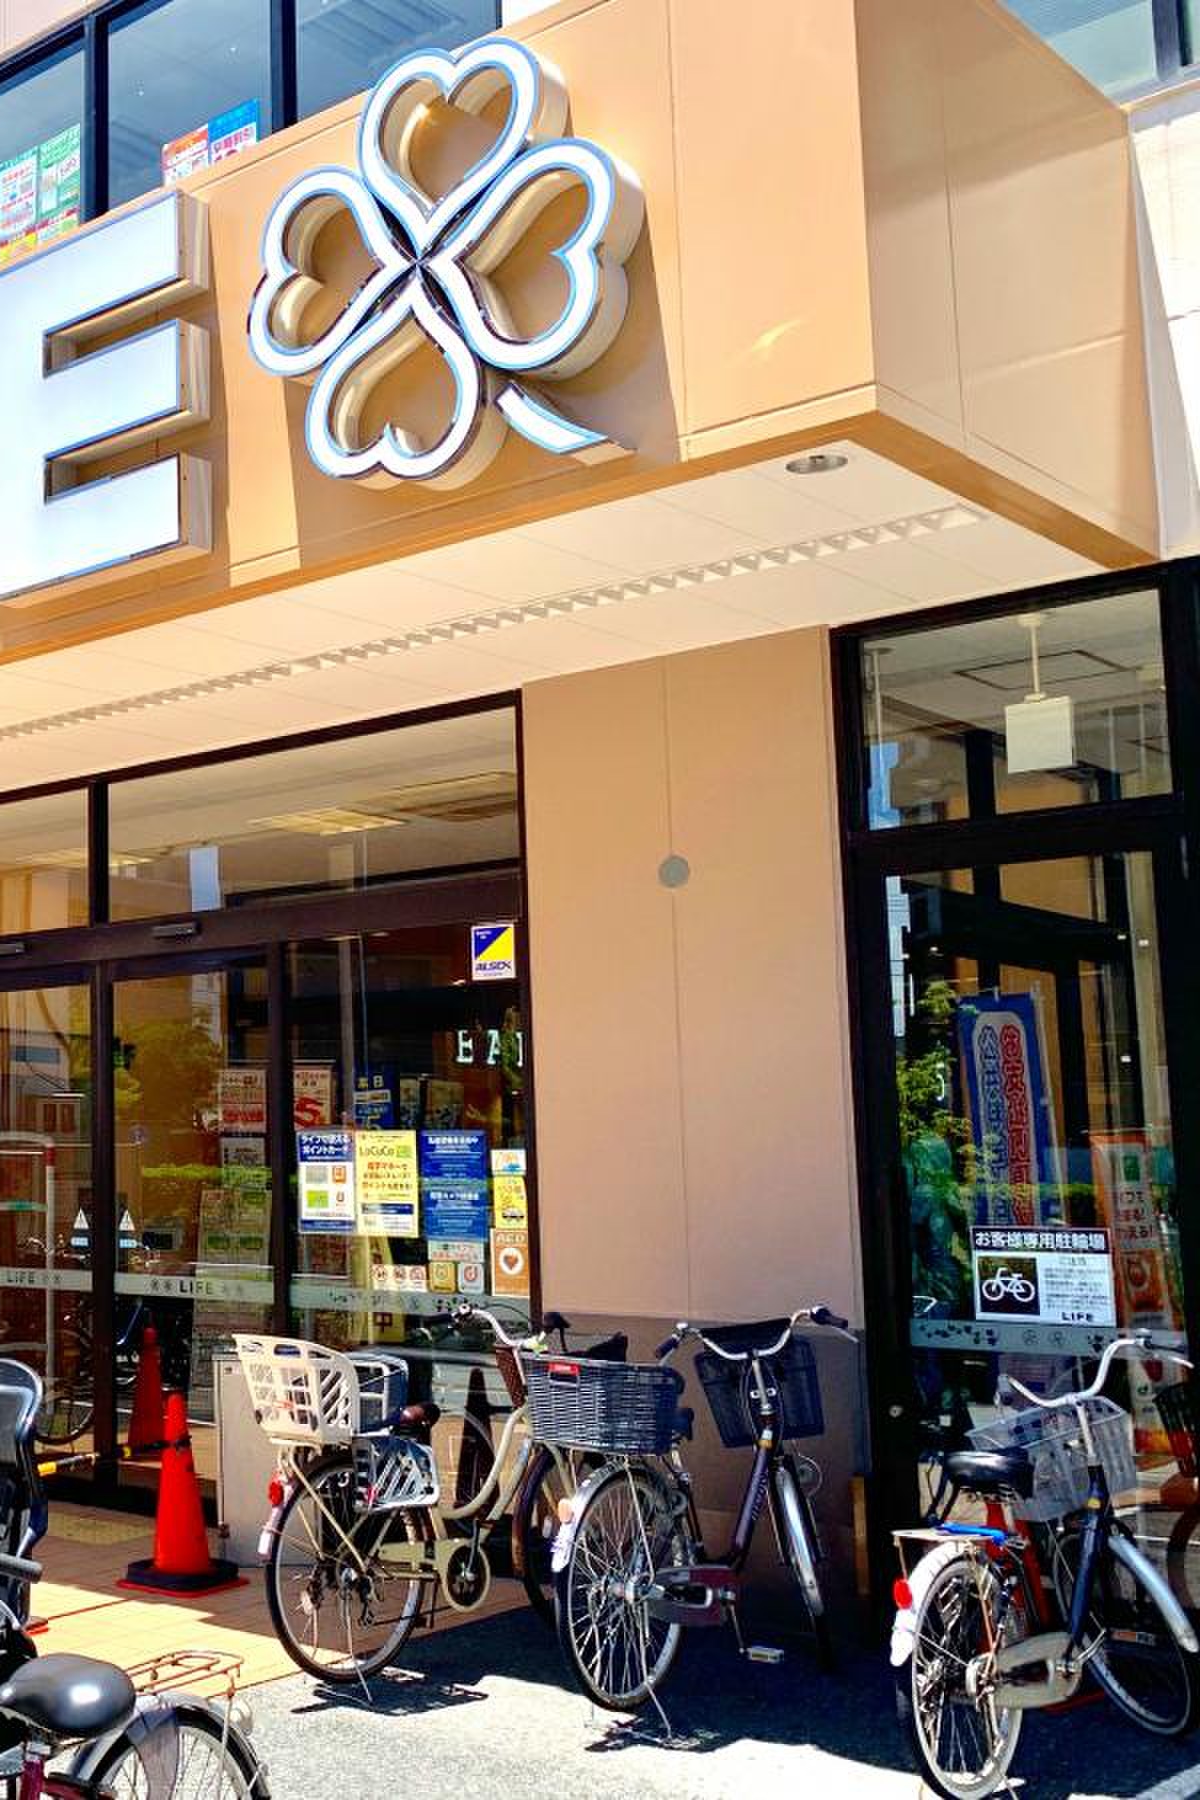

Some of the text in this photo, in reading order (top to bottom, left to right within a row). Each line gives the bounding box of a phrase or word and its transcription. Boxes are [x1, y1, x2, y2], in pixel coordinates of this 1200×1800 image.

[976, 1232, 1104, 1249] お客様専用駐輪場
[7, 1272, 35, 1284] LIFE
[179, 1280, 213, 1294] LIFE
[1062, 1312, 1094, 1321] LIFE
